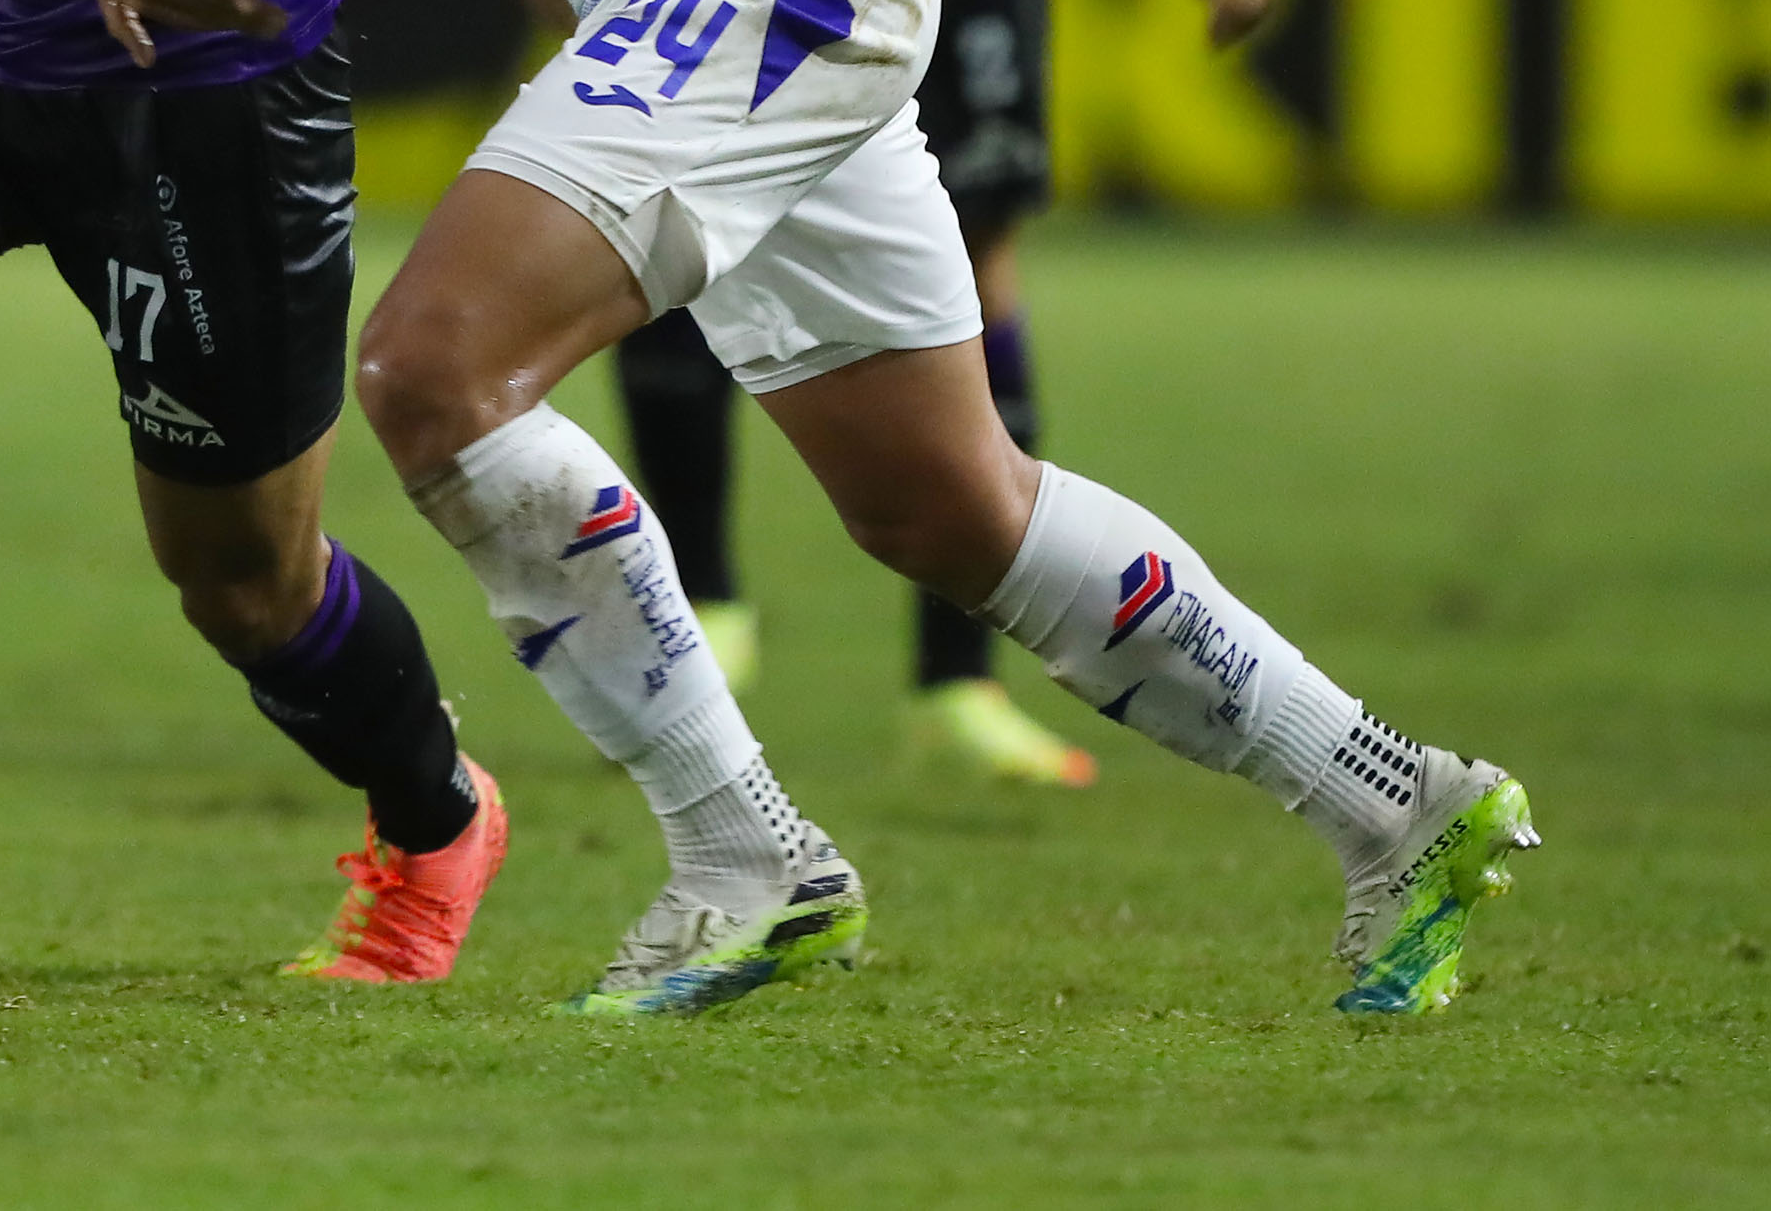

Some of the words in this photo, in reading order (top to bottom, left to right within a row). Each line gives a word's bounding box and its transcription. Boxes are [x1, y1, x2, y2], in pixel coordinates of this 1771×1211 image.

[105, 257, 167, 363] 17
[164, 218, 193, 282] Afore
[184, 288, 215, 356] Azteca
[1388, 818, 1468, 899] NEMESIS
